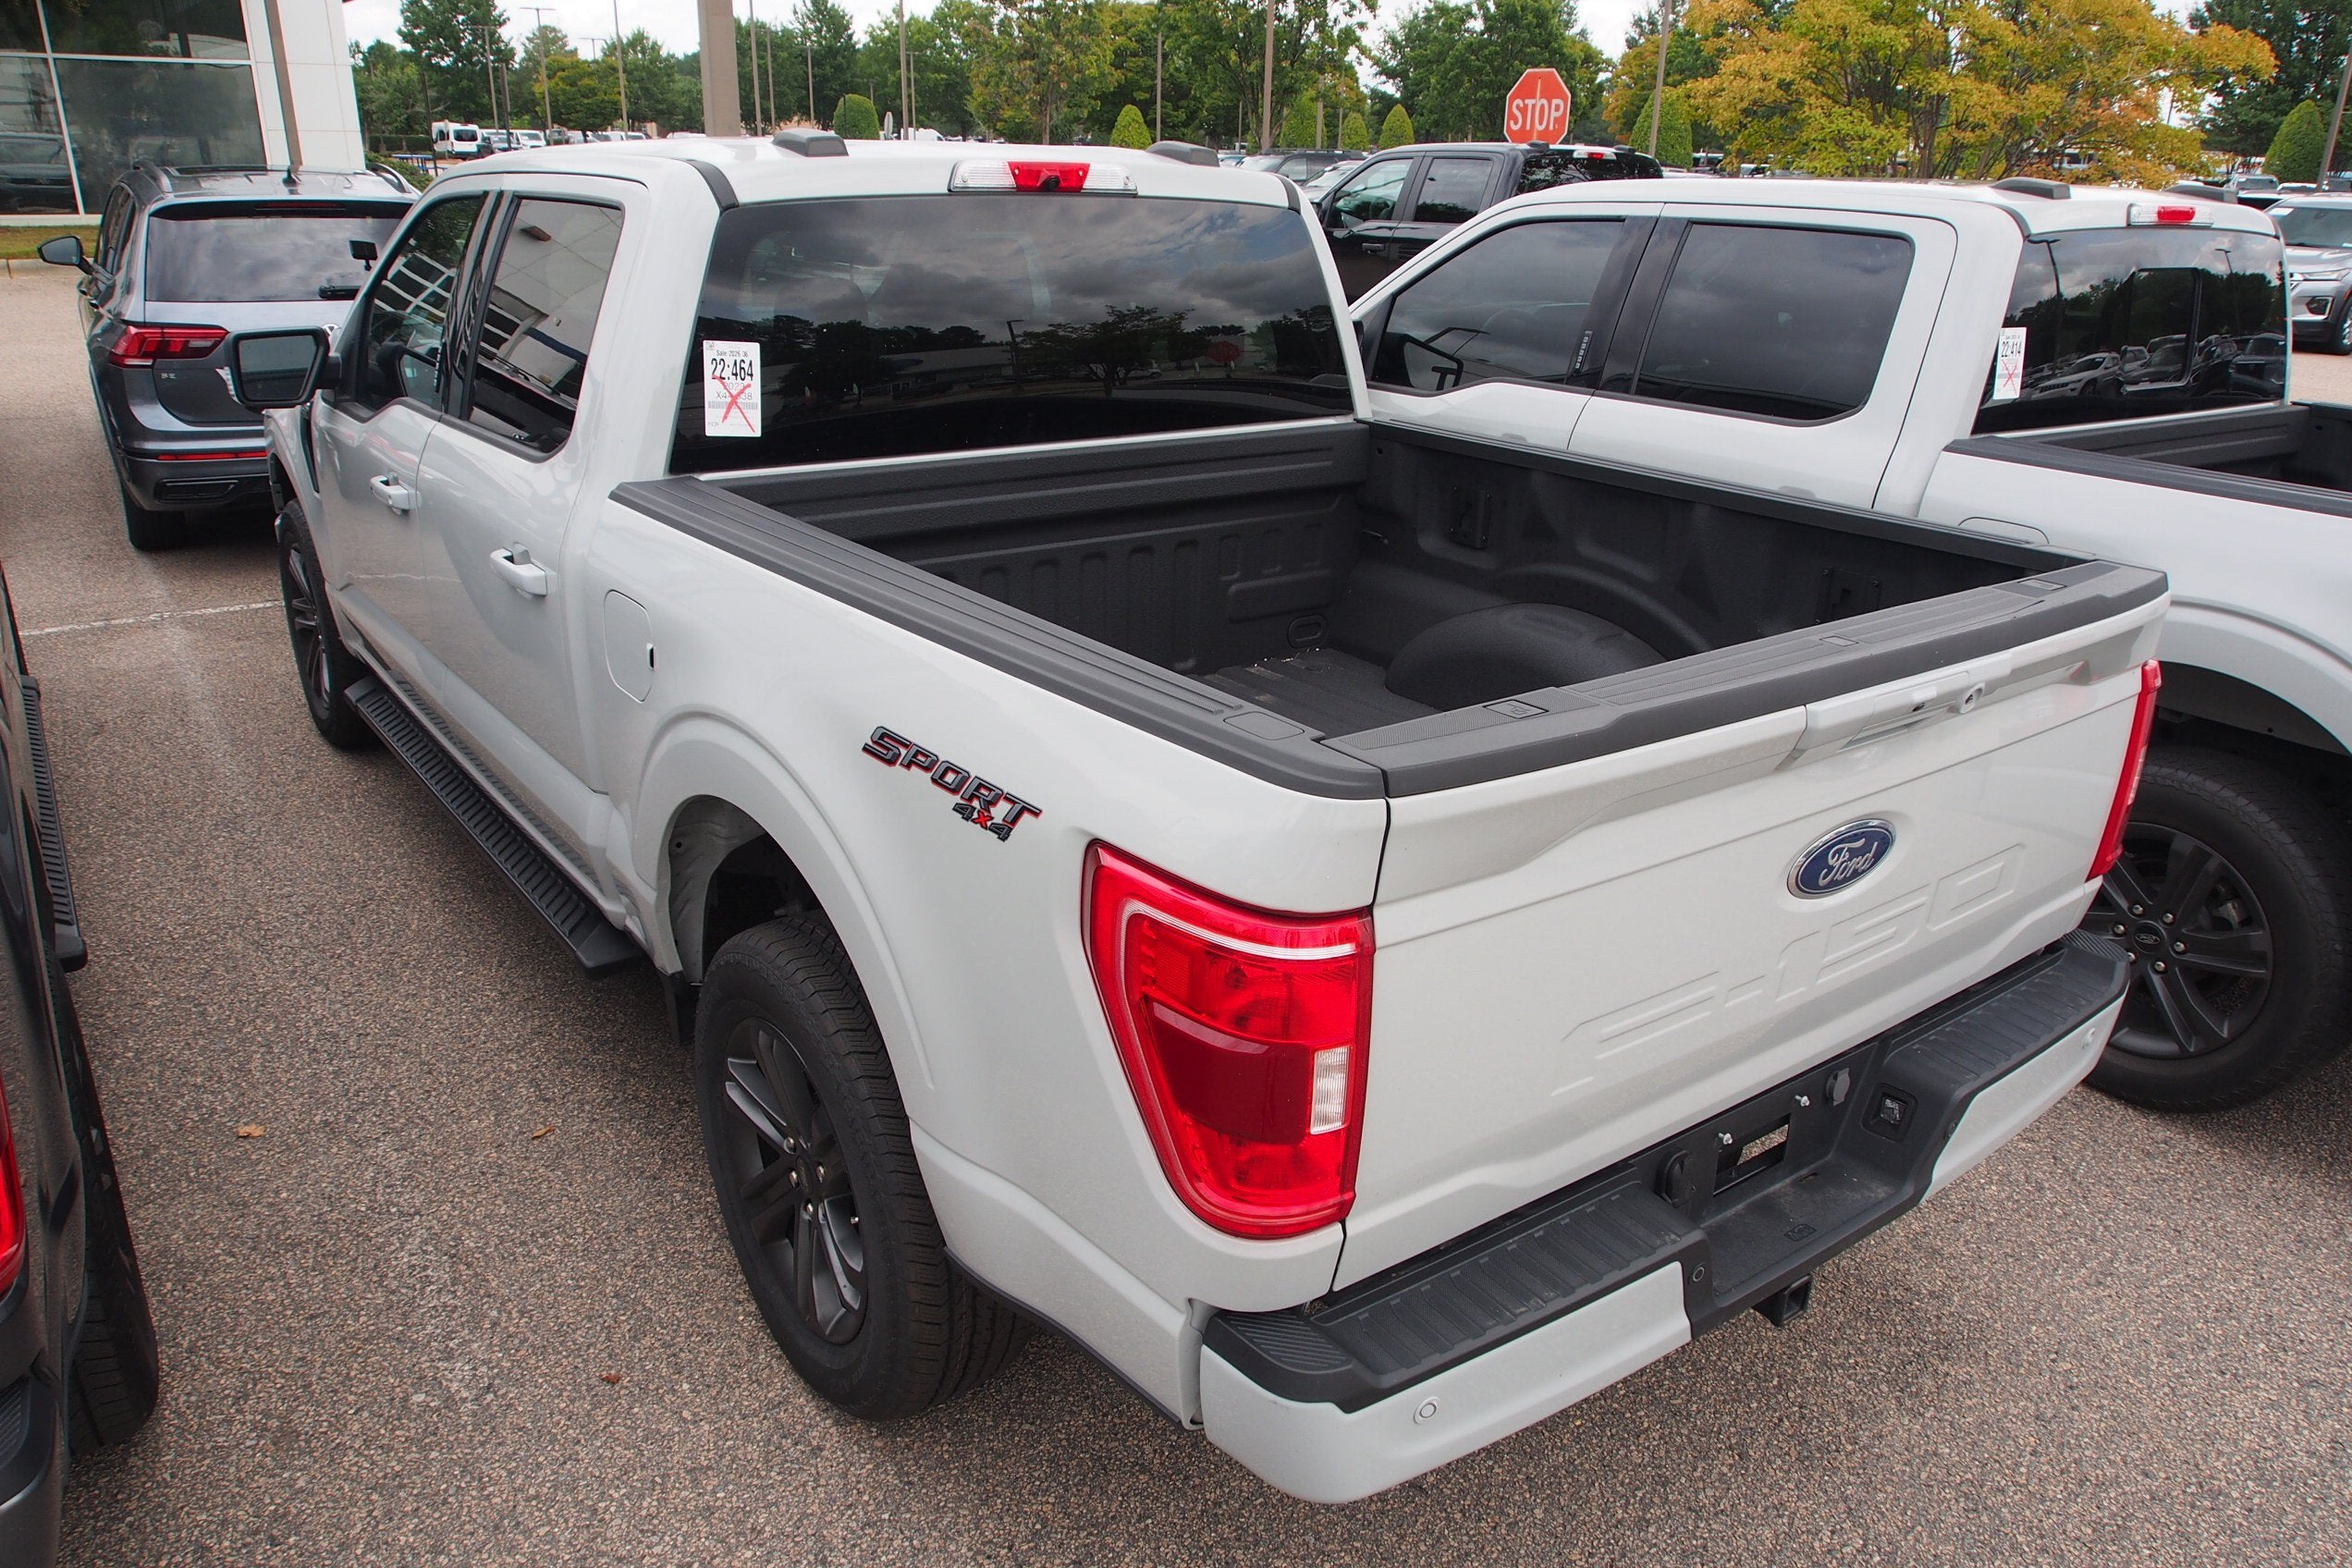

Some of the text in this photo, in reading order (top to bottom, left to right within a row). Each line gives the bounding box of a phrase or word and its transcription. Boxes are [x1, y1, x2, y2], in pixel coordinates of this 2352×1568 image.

[1510, 98, 1564, 131] STOP
[711, 358, 754, 381] 22:464
[862, 725, 1043, 829] SPORT
[1818, 838, 1879, 887] Ford
[1550, 842, 2027, 1096] F-150
